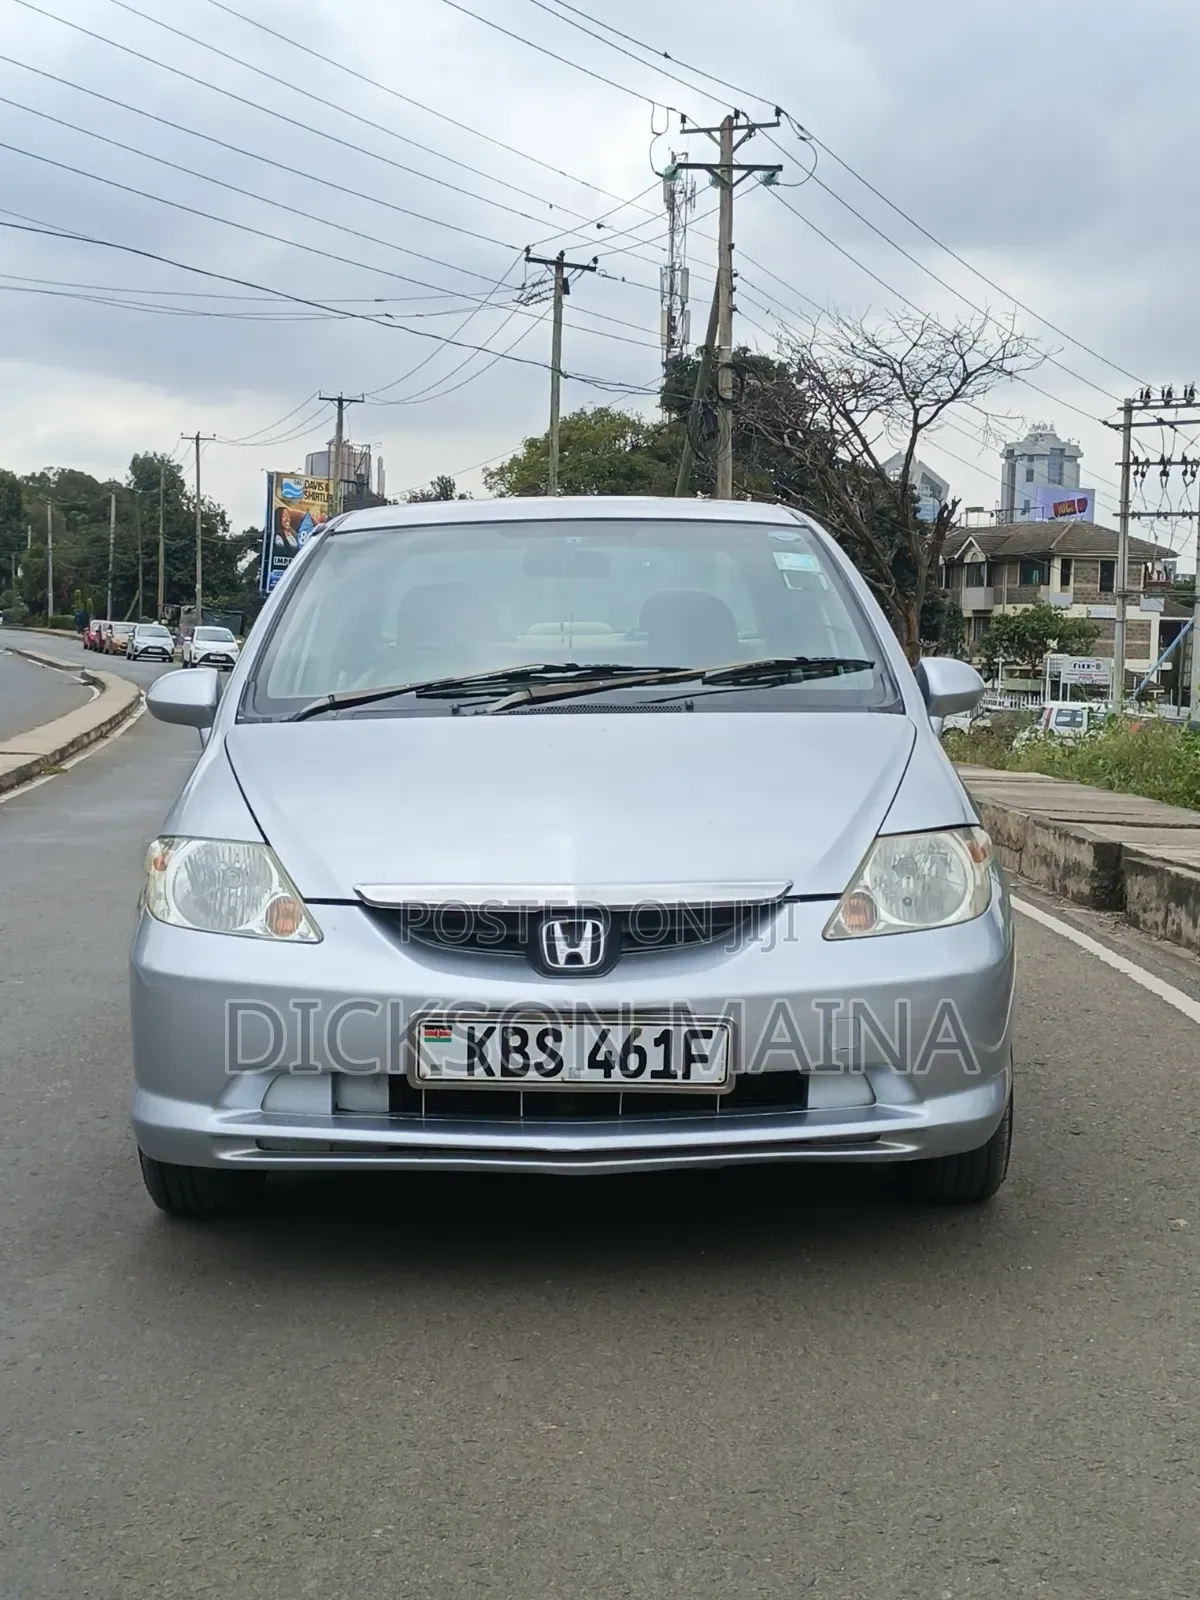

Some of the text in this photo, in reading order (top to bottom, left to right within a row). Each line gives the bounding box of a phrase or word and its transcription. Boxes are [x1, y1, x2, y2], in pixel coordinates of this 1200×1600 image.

[304, 479, 325, 491] DAVIS
[467, 1025, 564, 1078] KBS
[587, 1028, 713, 1080] 461F
